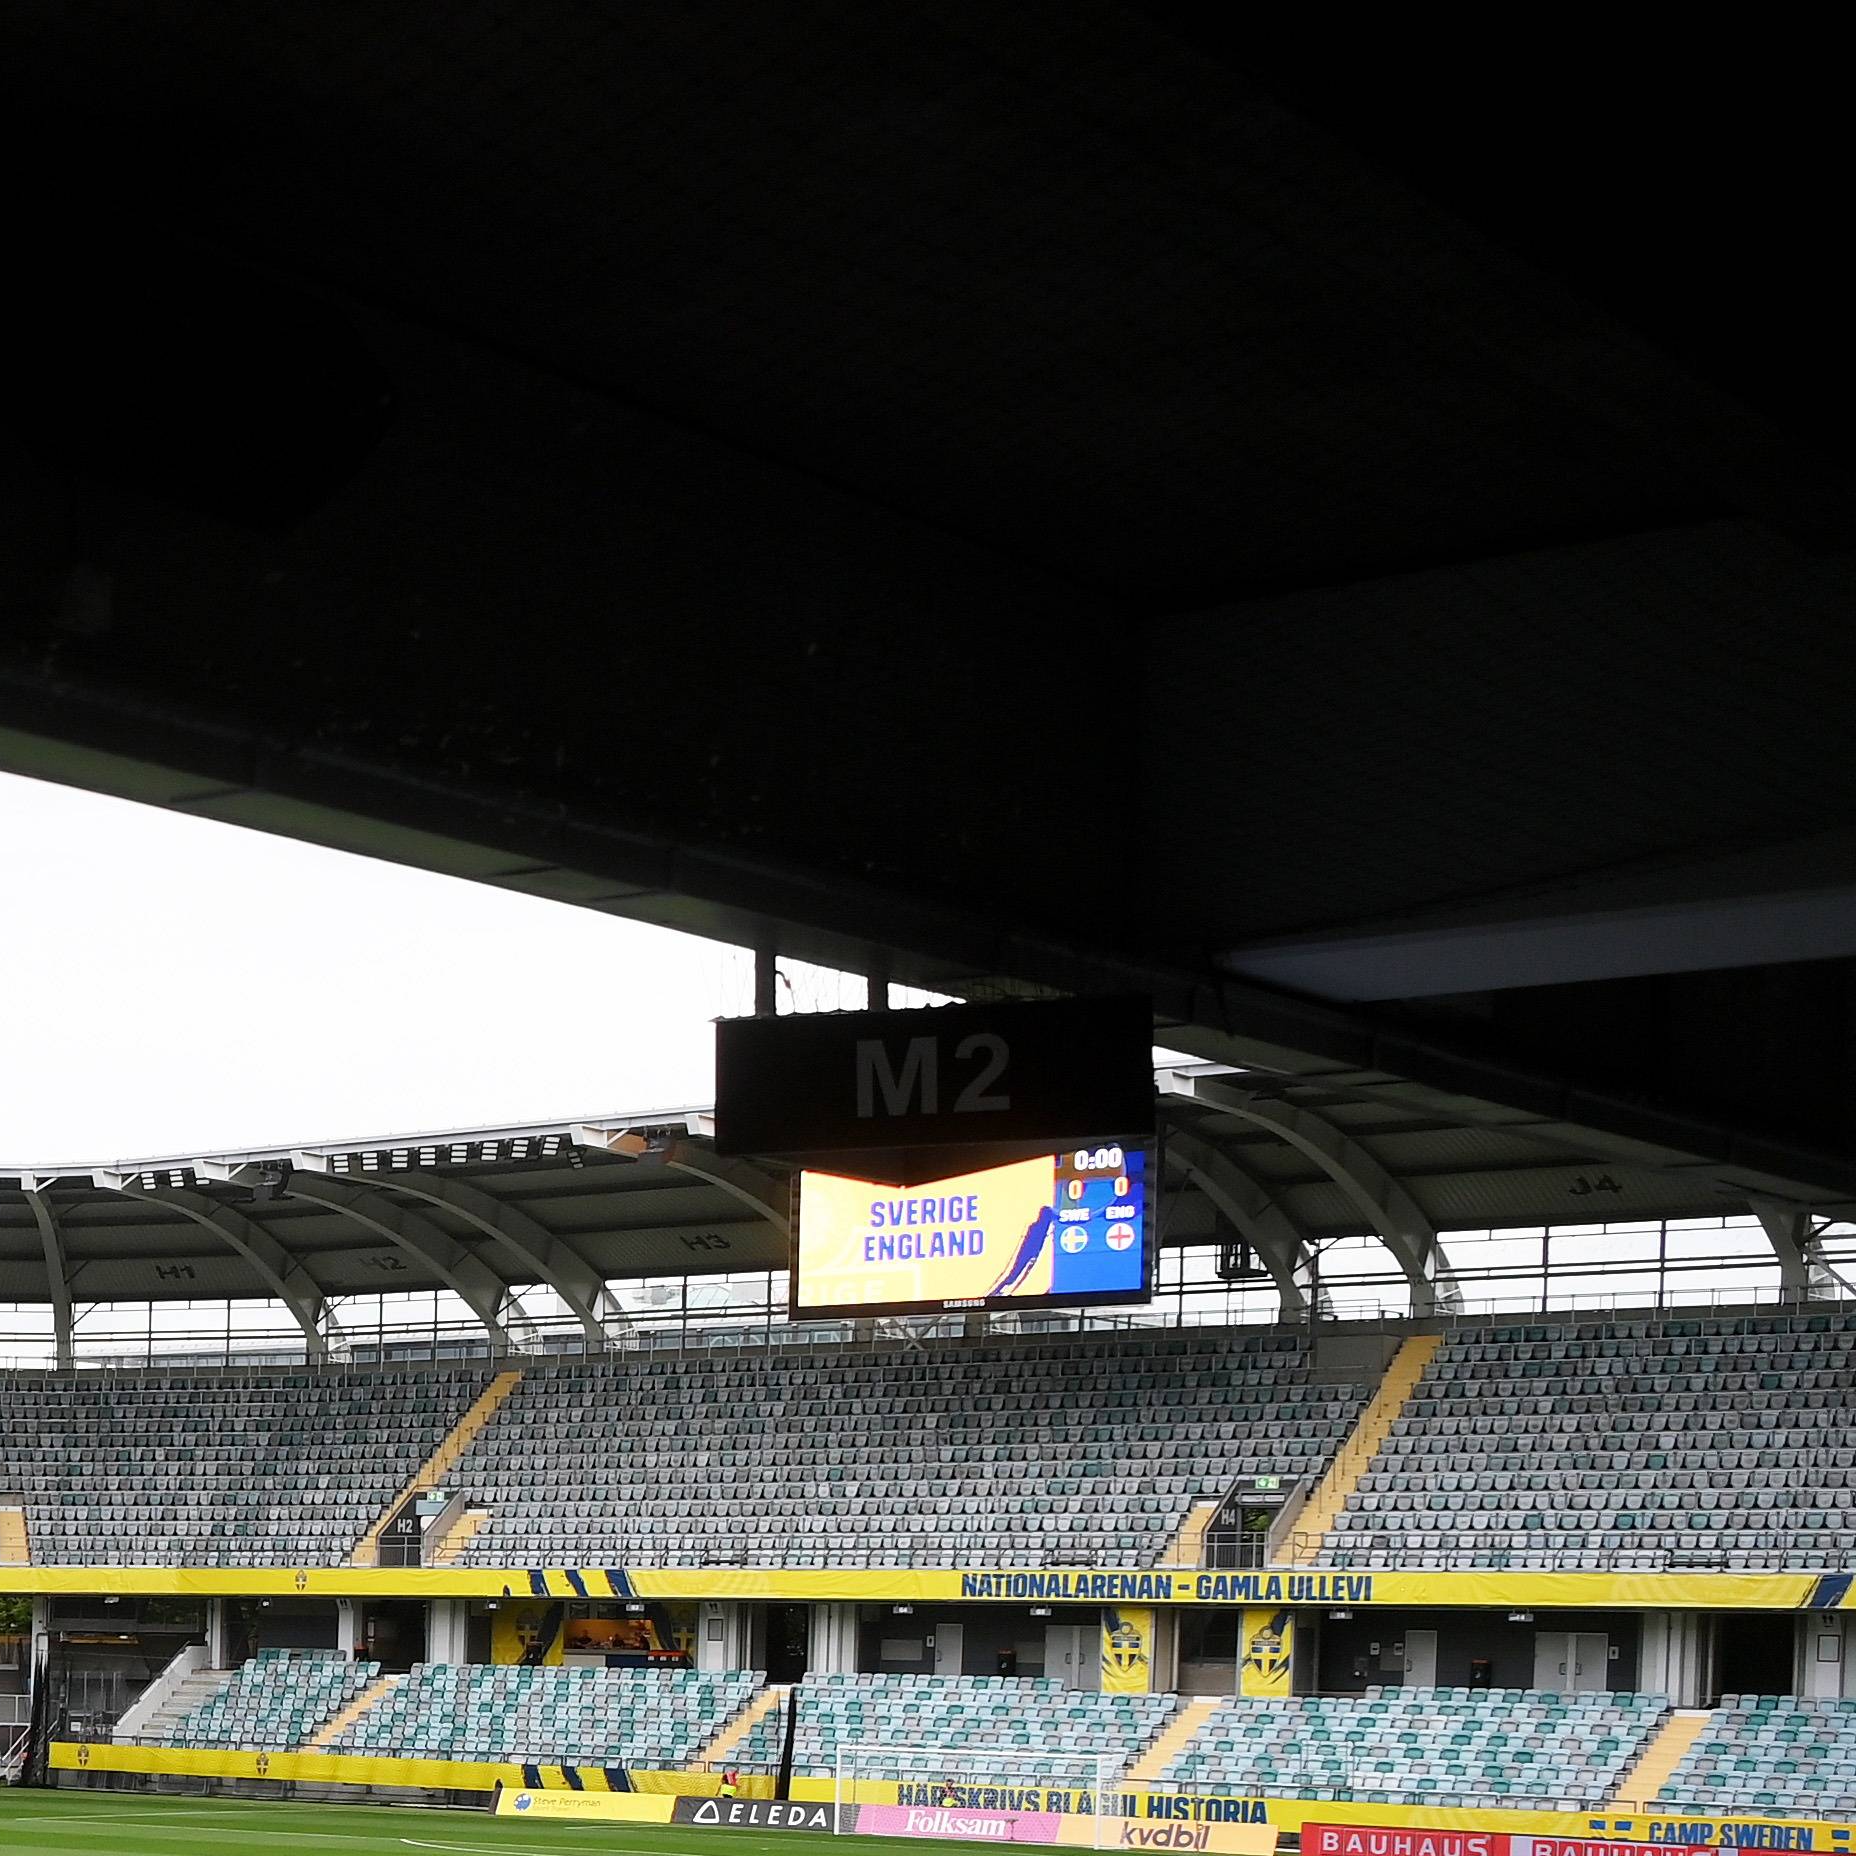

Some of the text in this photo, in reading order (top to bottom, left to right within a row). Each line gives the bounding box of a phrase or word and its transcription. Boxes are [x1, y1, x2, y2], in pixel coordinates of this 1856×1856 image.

[856, 1033, 1011, 1117] M2
[1074, 1147, 1123, 1171] 0:00
[1069, 1176, 1128, 1200] 0 0
[870, 1195, 979, 1228] SVERIGE
[1059, 1205, 1135, 1222] SWE ENG
[864, 1229, 985, 1262] ENGLAND
[397, 1518, 413, 1533] H2
[961, 1574, 1172, 1599] NATIONALARENAN
[1196, 1575, 1282, 1600] GAMLA
[1288, 1576, 1373, 1601] ULLEVI
[728, 1803, 828, 1828] ELEDA
[946, 1787, 1040, 1813] SKRIVS
[1148, 1796, 1268, 1825] HISTORIA
[904, 1808, 1008, 1837] Folksam
[1119, 1821, 1211, 1850] kvdbil
[1649, 1822, 1813, 1851] CAMP SWEDEN
